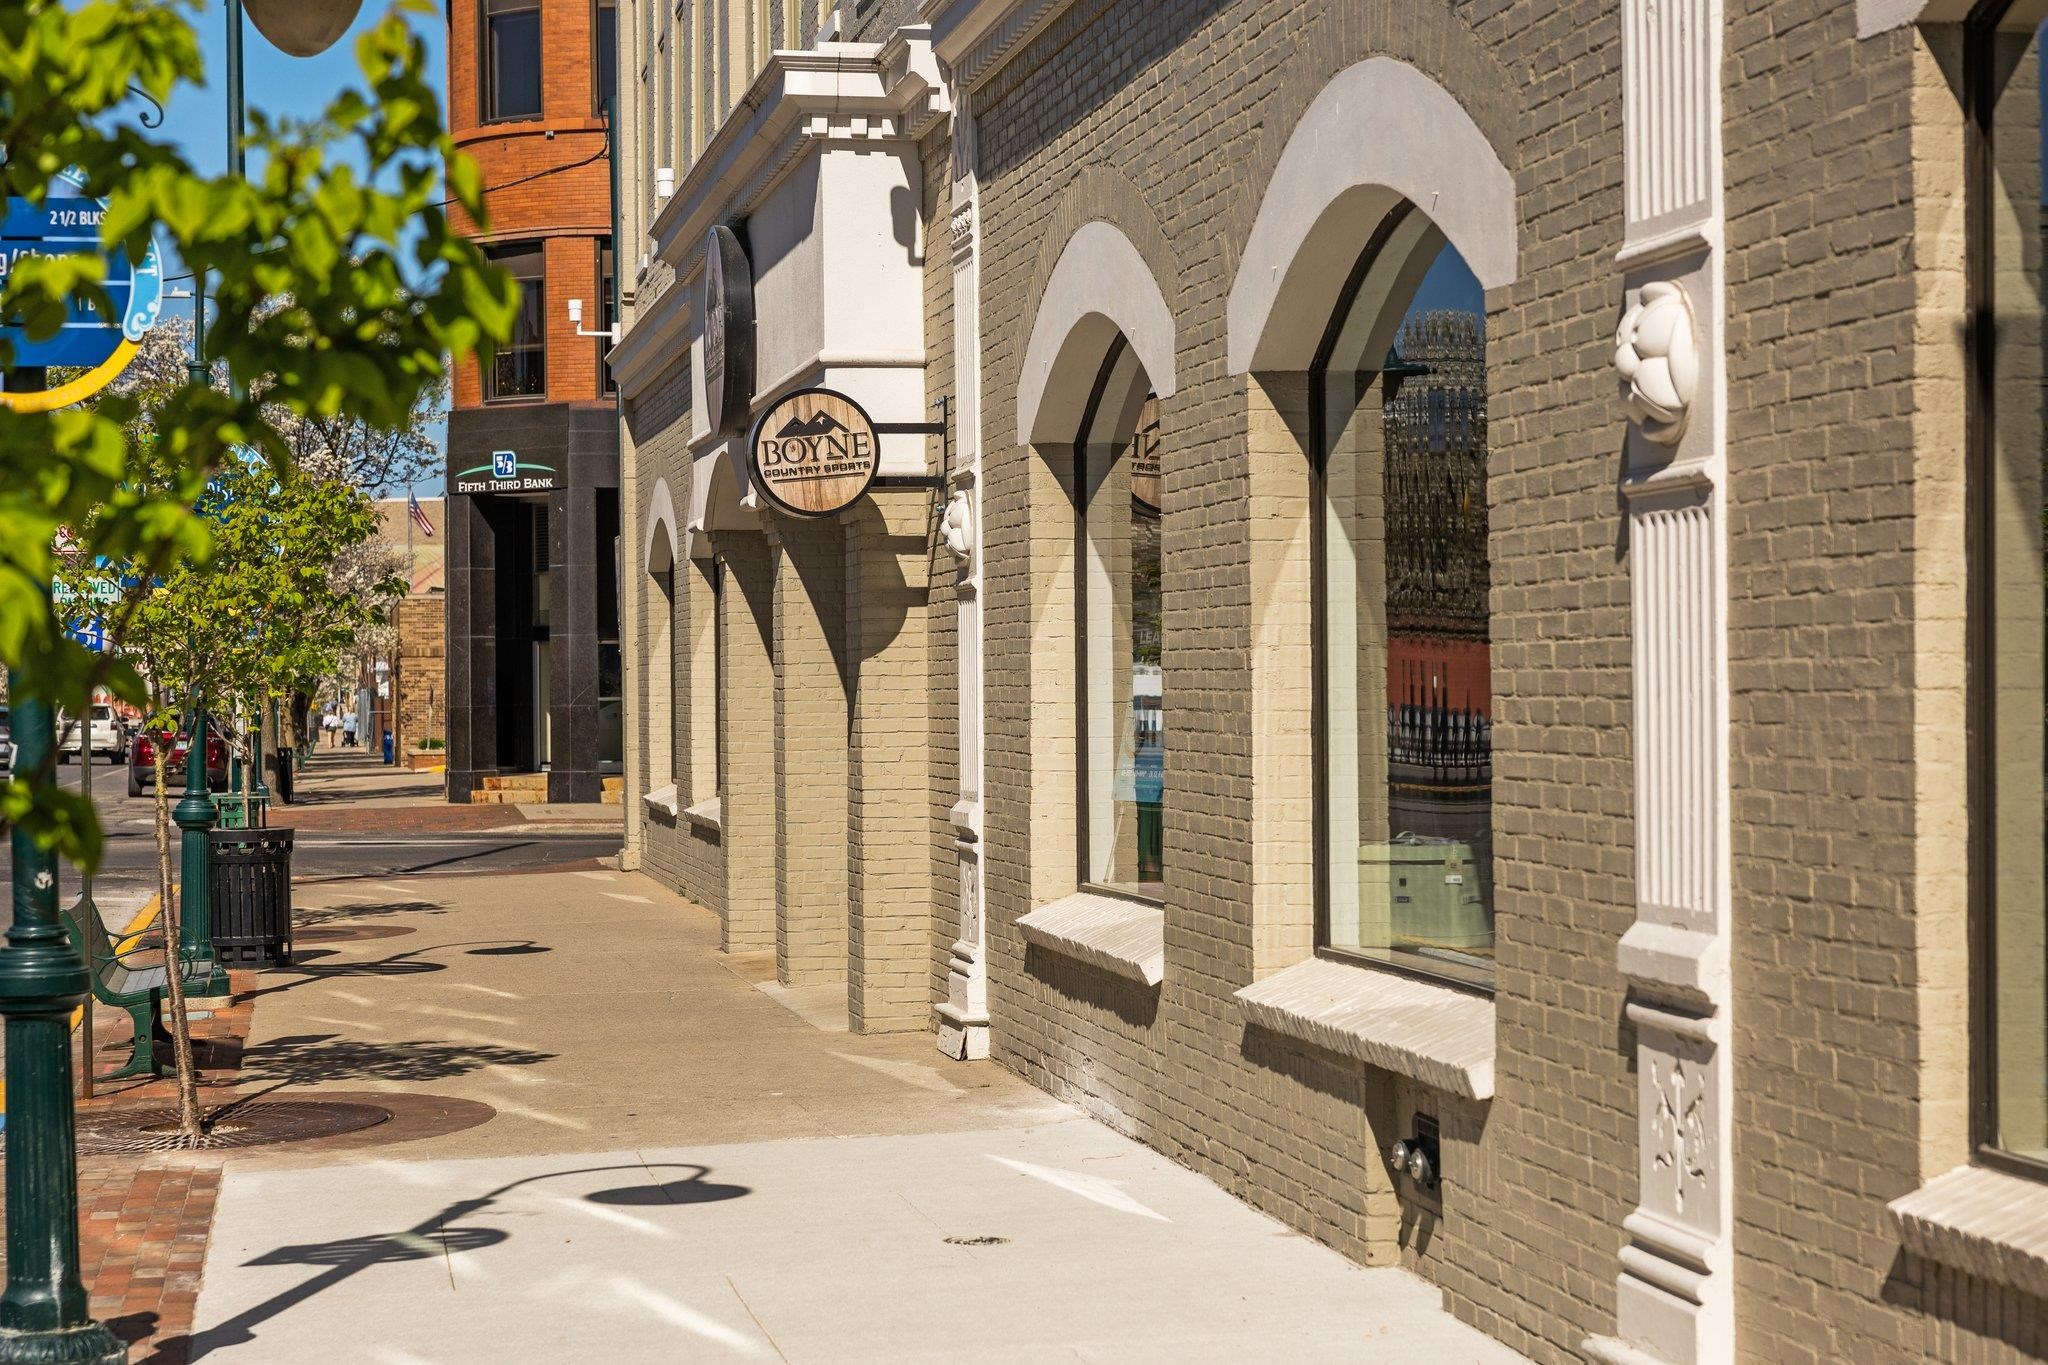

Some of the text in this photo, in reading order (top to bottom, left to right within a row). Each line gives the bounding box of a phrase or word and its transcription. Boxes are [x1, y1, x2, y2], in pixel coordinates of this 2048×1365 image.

[49, 209, 107, 227] 2 1/2 BLKS
[761, 432, 871, 466] BOYNE
[763, 461, 871, 479] COUNTRY SPORTS
[458, 477, 553, 492] FIFTH THIRD BANK
[53, 581, 116, 594] REVED
